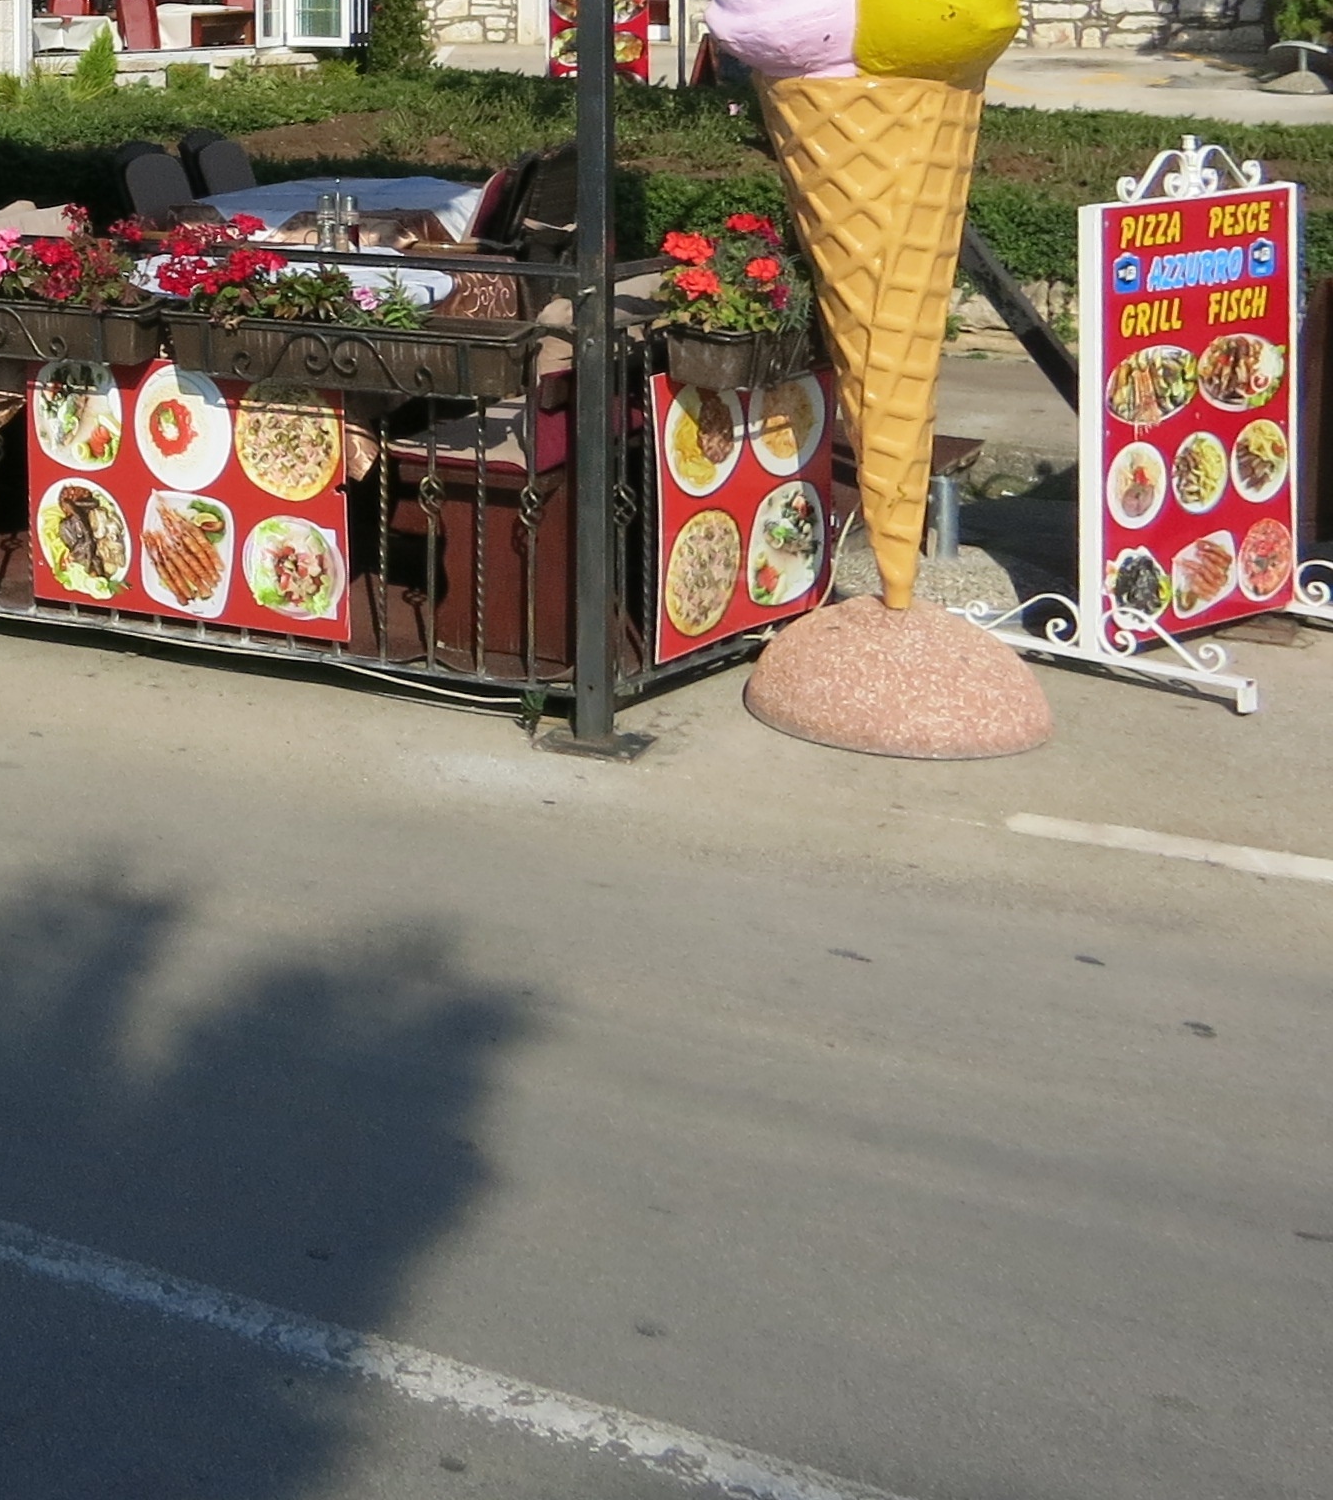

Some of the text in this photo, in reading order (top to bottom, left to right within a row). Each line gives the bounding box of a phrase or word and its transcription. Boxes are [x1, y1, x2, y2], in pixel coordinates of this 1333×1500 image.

[1120, 201, 1271, 249] PIZZA PESCE
[1147, 246, 1243, 292] AZZURRO
[1120, 285, 1268, 338] GRILL FISCH
